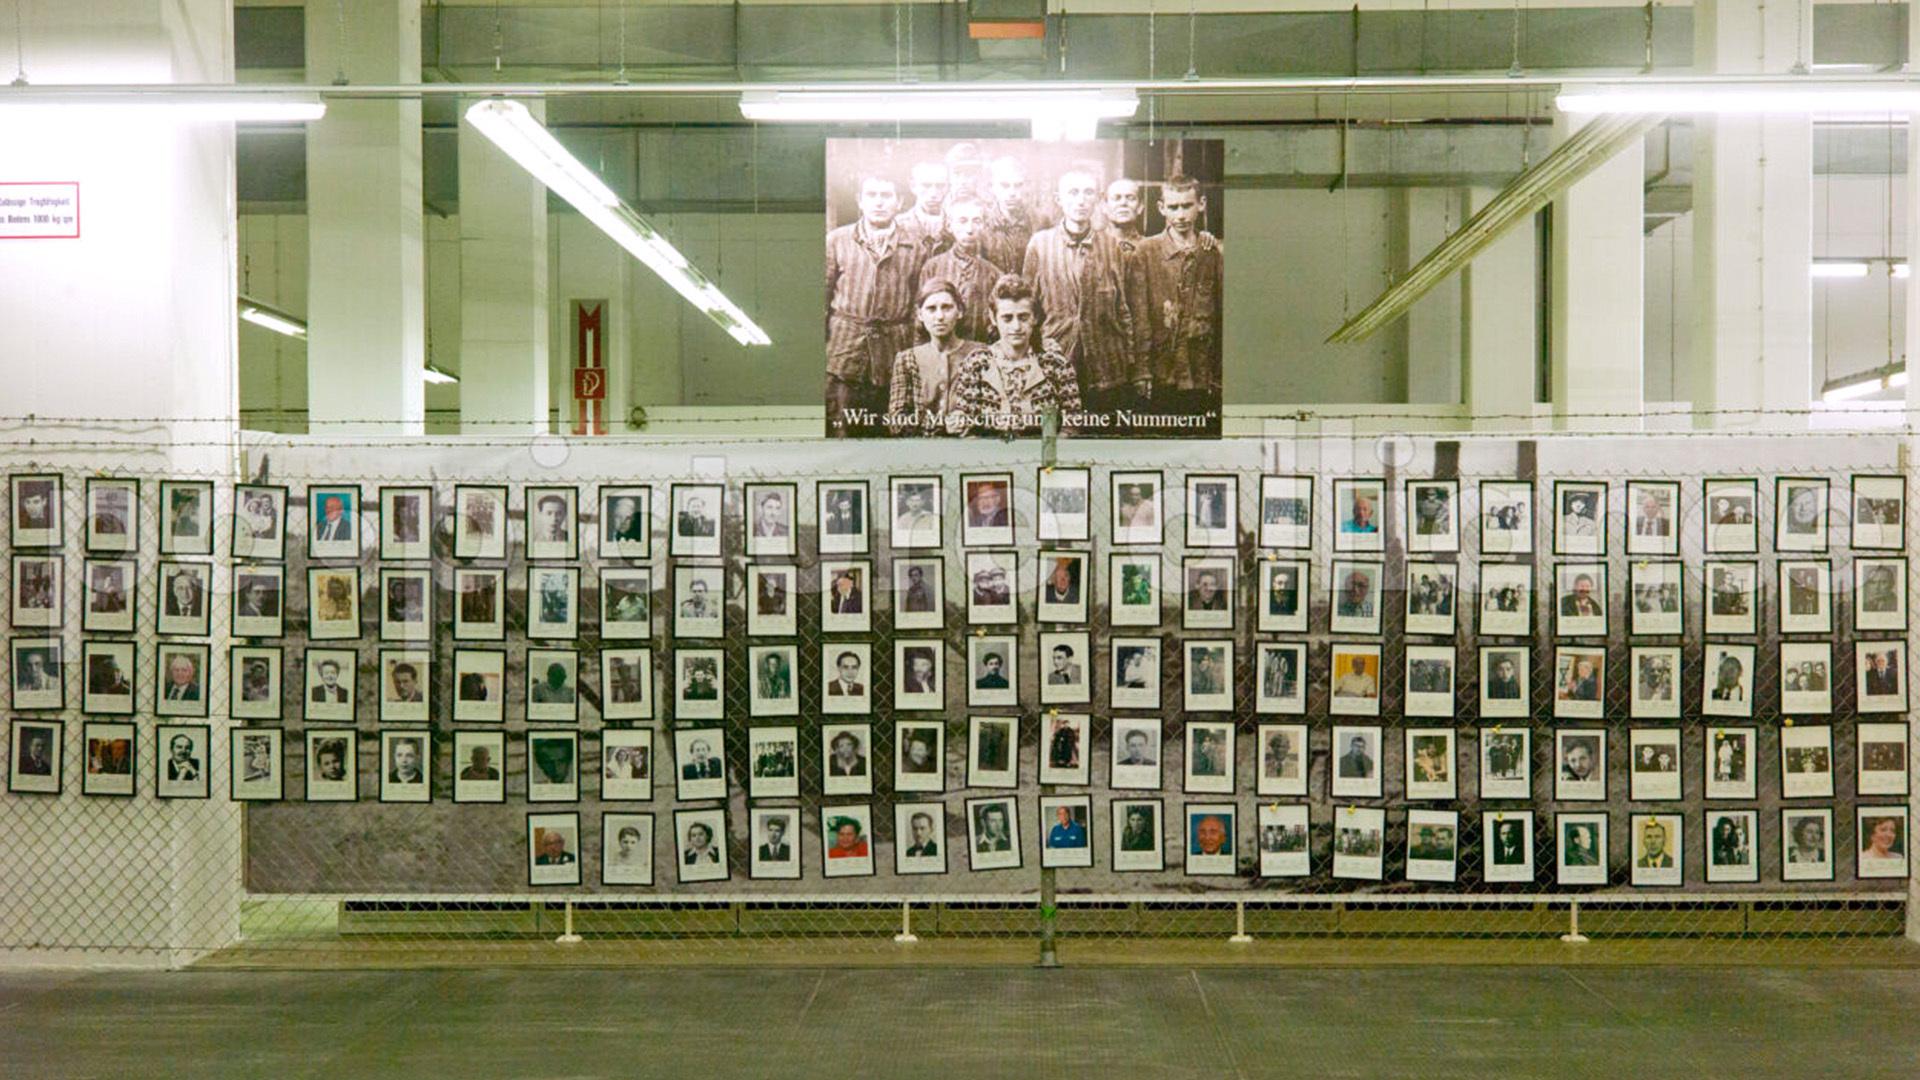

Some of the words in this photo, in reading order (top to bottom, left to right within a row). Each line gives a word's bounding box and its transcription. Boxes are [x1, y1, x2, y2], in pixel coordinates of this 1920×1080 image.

[52, 213, 61, 225] kg
[882, 408, 919, 426] sind
[924, 409, 1020, 426] Menschen
[1023, 411, 1045, 426] un
[1061, 409, 1110, 427] keine
